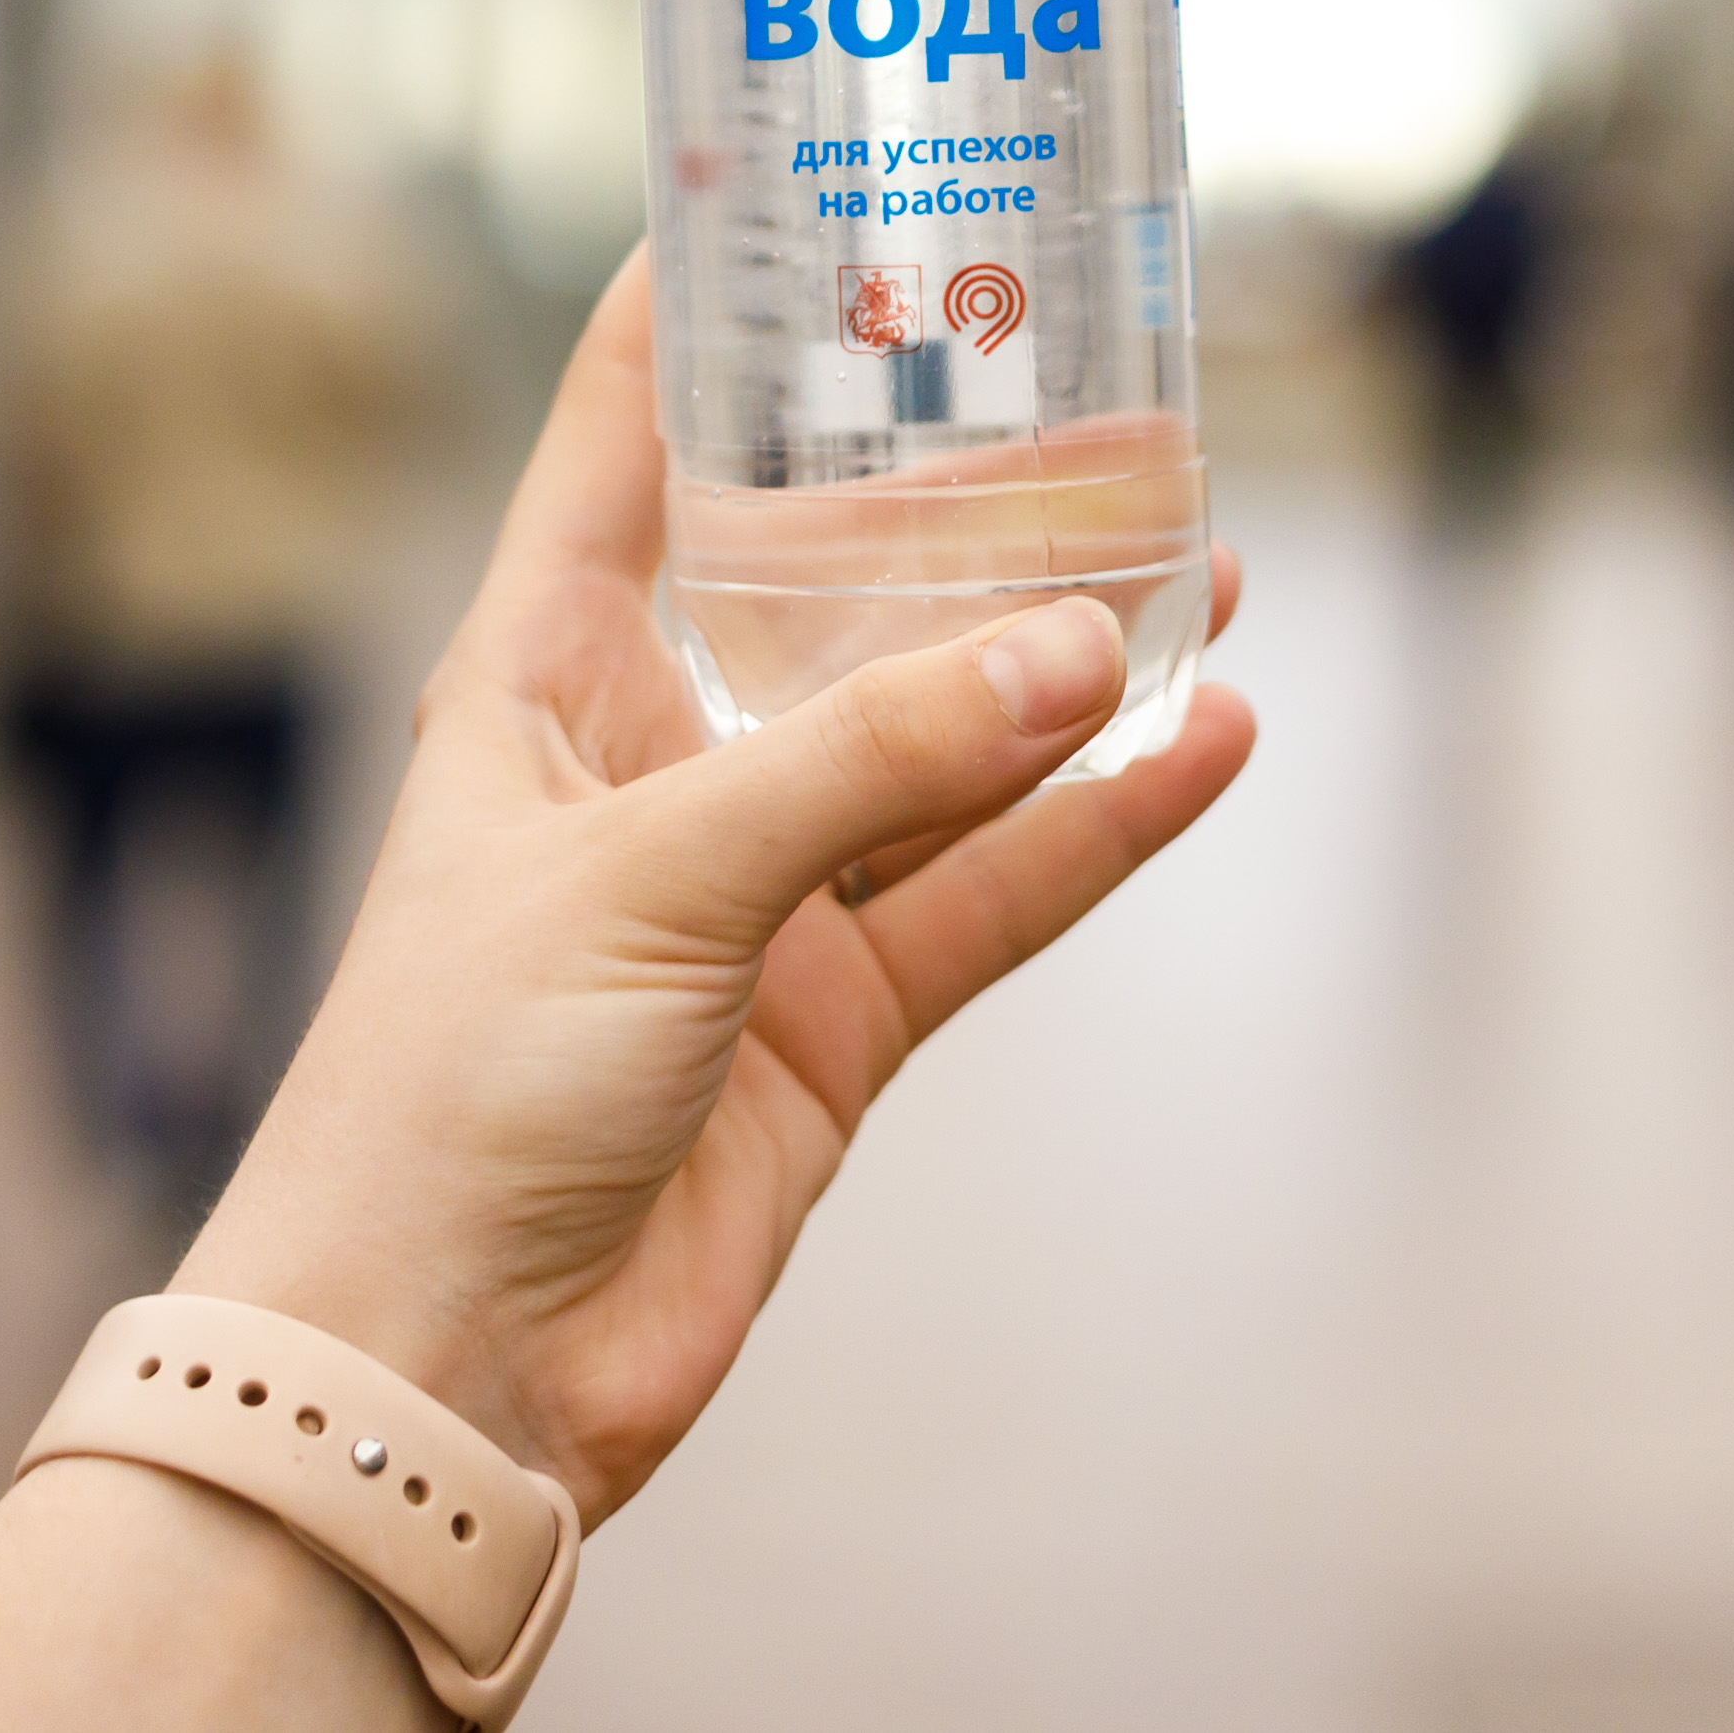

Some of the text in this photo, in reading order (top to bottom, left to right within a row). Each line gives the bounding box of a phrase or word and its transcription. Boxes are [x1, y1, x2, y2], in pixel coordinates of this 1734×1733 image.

[791, 132, 1058, 177] для успехов
[817, 177, 1037, 226] на работе
